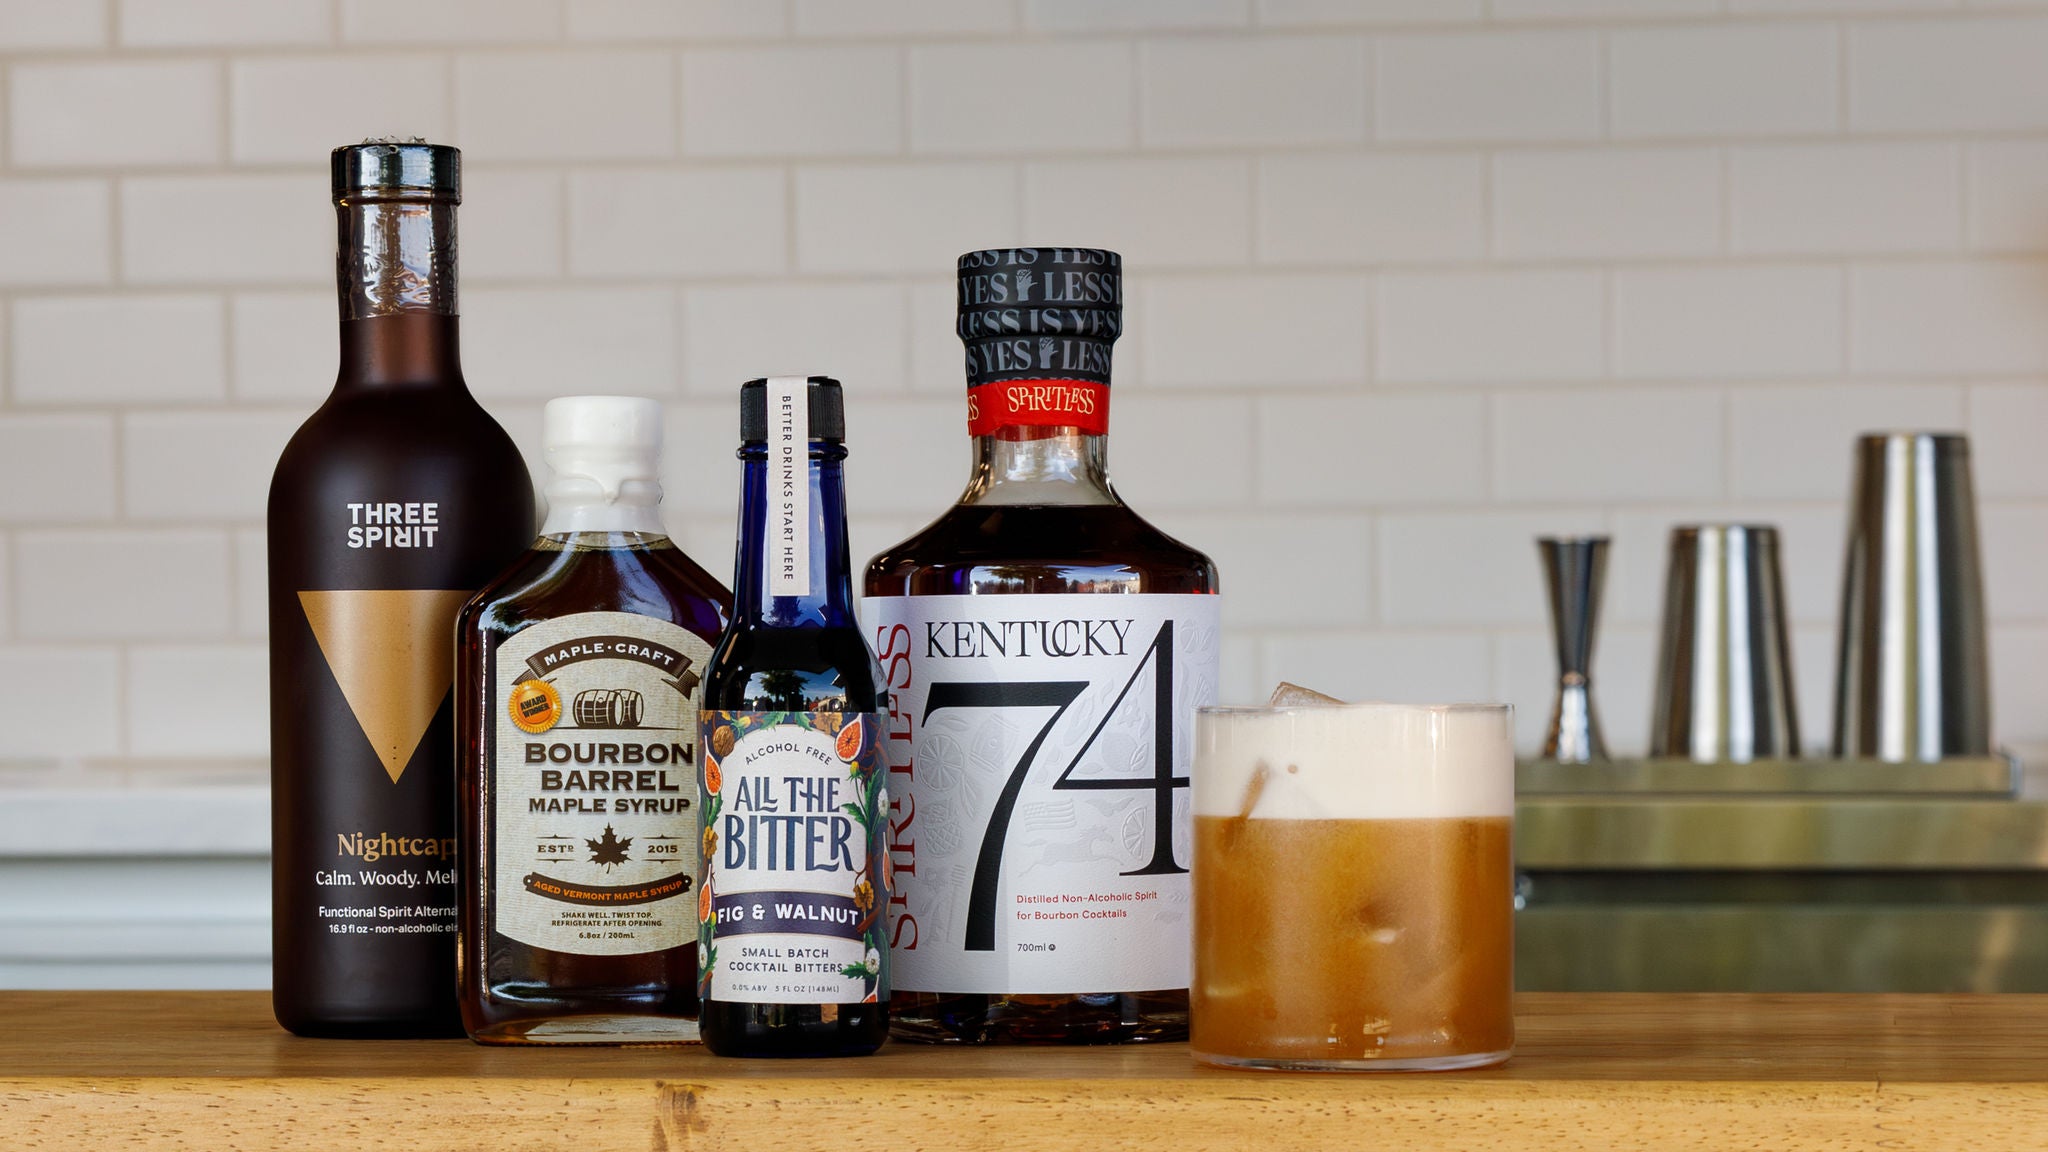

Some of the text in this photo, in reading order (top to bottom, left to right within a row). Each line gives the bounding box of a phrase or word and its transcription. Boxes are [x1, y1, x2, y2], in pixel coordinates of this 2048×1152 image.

[962, 272, 1008, 306] YES
[1044, 271, 1114, 303] LESS
[1030, 309, 1062, 334] IS
[1069, 309, 1116, 337] YES
[980, 340, 1032, 373] YES
[1062, 341, 1110, 375] LESS
[1007, 386, 1095, 415] SPIRITLESS
[782, 396, 794, 580] BETTER DRINKS START HERE
[347, 502, 438, 524] THREE
[347, 526, 439, 548] SPIRIT
[925, 619, 1135, 659] KENTUCKY
[520, 694, 547, 711] AWARD
[522, 703, 550, 718] WINNER
[525, 743, 694, 764] BOURBON
[745, 743, 832, 766] ALCOHOL FREE
[541, 770, 680, 792] BARREL
[921, 619, 1190, 952] 74
[734, 776, 841, 813] ALL THE
[528, 798, 691, 813] MAPLE SYRUP
[337, 832, 457, 862] Nightcap
[648, 844, 678, 853] 2015
[725, 815, 854, 872] BITTER
[316, 870, 356, 886] Calm.
[359, 870, 421, 889] Woody.
[533, 880, 683, 901] AGED VERMONT MAPLE SYRUP
[1016, 891, 1157, 904] Distilled Non-Alcoholic Spirit
[319, 906, 376, 917] Functional
[378, 906, 412, 919] Spirit
[717, 904, 859, 925] FIG & WALNUT
[1017, 909, 1127, 920] for Bourbon Cocktails
[329, 924, 347, 933] 16.9
[348, 924, 355, 933] fl
[375, 923, 443, 933] non-alcoholic
[742, 948, 829, 958] SMALL BATCH
[1017, 943, 1046, 952] 700ml
[729, 962, 843, 973] COCKTAIL BITTERS
[794, 985, 805, 993] OZ
